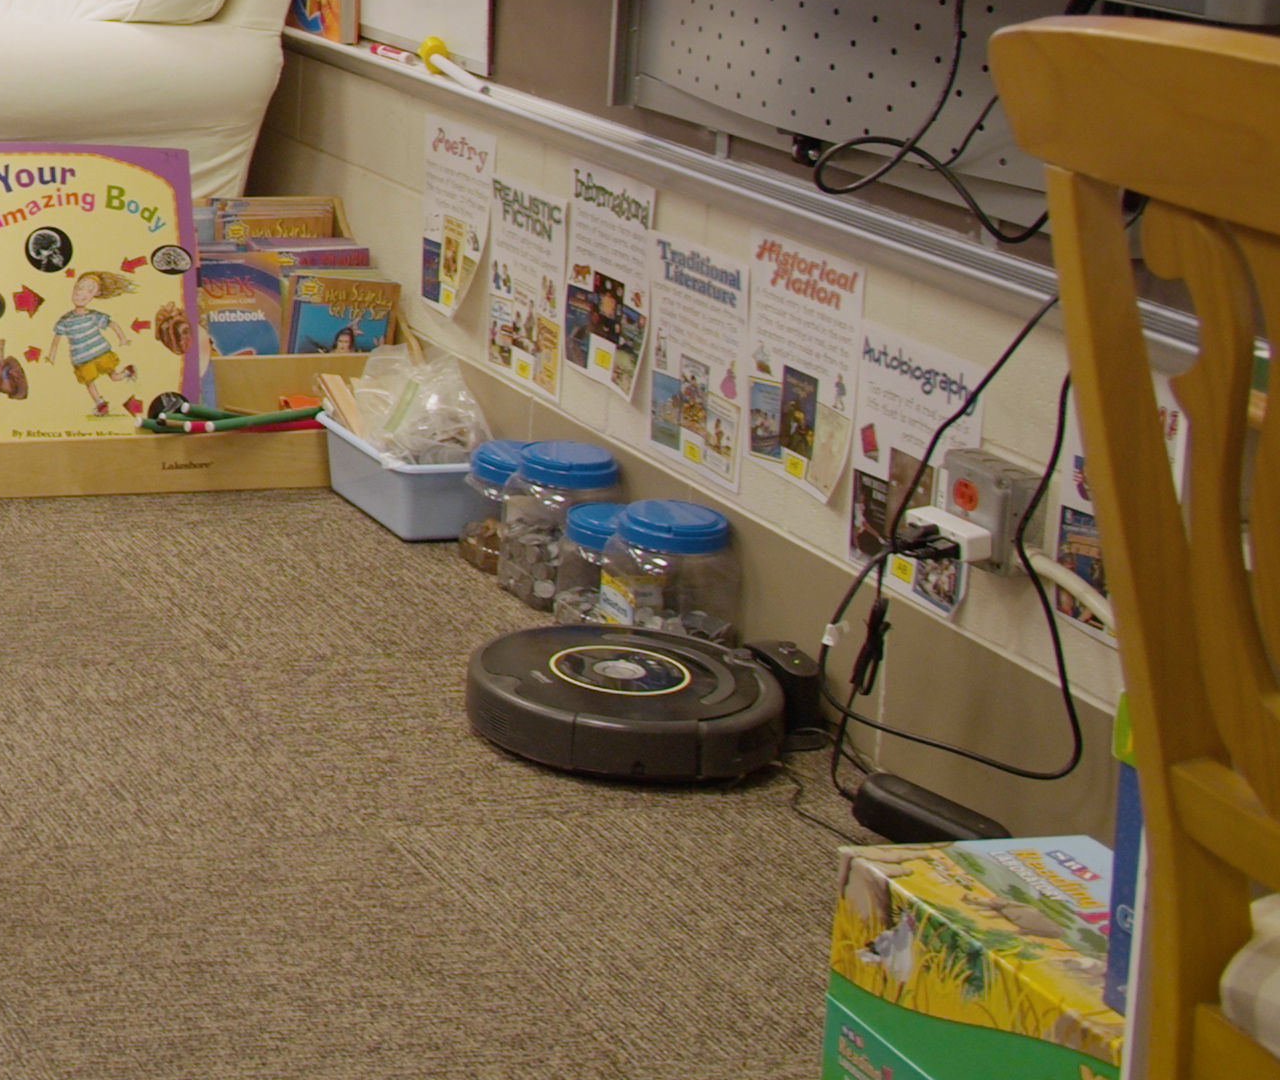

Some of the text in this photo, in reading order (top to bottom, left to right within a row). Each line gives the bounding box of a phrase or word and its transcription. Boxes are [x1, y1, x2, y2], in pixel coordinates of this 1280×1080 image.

[432, 127, 489, 173] Poetry
[104, 184, 167, 234] Body
[492, 177, 563, 225] REALISTIC
[502, 202, 553, 243] FICTION
[573, 168, 651, 231] Informational
[658, 238, 742, 291] Traditional
[664, 261, 737, 308] Literature
[755, 238, 859, 295] Historical
[770, 263, 842, 312] Fiction
[209, 309, 266, 324] Notebook
[12, 429, 23, 439] By
[26, 429, 62, 439] Rebecca
[161, 461, 213, 471] Lakeshore
[1008, 848, 1108, 909] Reading
